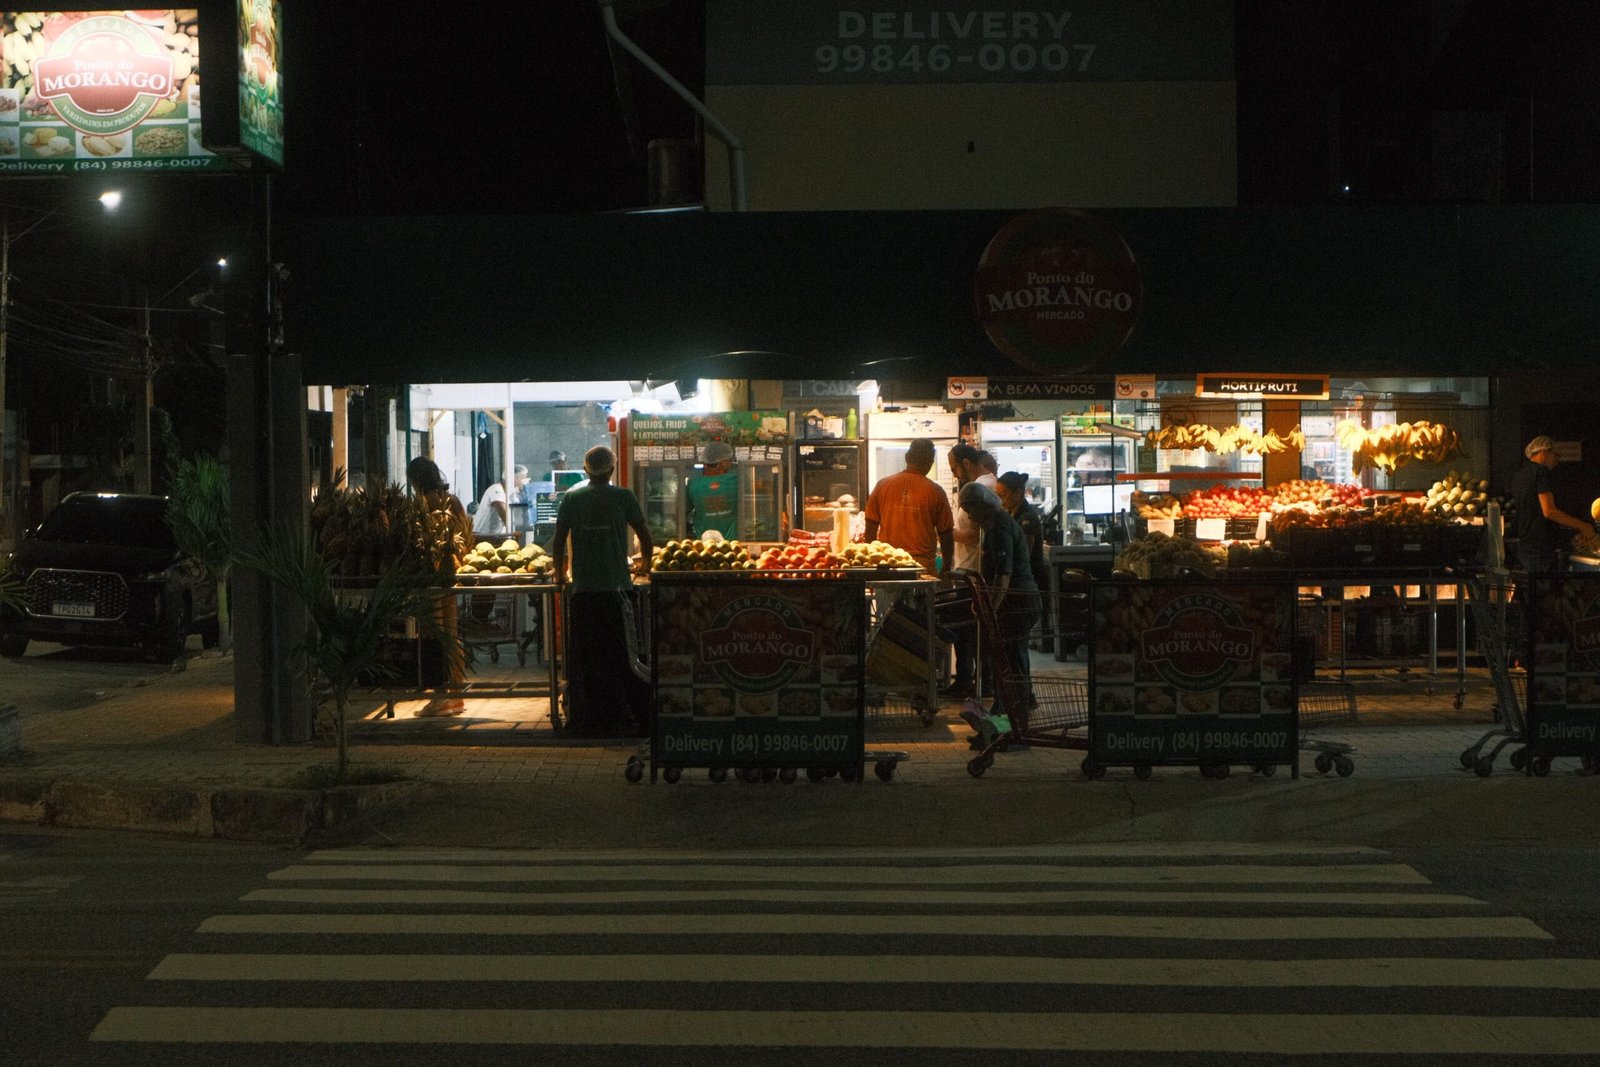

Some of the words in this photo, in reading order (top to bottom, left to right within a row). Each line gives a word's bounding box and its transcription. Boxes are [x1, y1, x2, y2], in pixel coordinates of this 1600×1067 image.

[838, 11, 1072, 39] DELIVERY
[75, 60, 113, 70] Ponto
[117, 60, 134, 70] do
[815, 43, 1096, 73] 99846-0007
[43, 71, 166, 92] MORANGO
[0, 162, 64, 172] Delivery
[74, 160, 106, 170] (84)
[1027, 272, 1071, 285] Ponto
[1075, 272, 1095, 284] do
[986, 286, 1132, 312] MORANGO
[1037, 311, 1085, 320] MERCADO
[812, 380, 858, 396] CAIX
[1006, 384, 1042, 396] BEM
[1044, 384, 1096, 395] VINDOS
[1220, 380, 1298, 392] HORTIFRUTI
[633, 420, 664, 430] QUEIJOS,
[666, 420, 688, 430] FRIOS
[724, 596, 792, 618] MERCADO
[1164, 597, 1232, 617] MERCADO
[732, 632, 765, 640] Ponto
[768, 632, 782, 640] do
[1174, 630, 1206, 640] Ponto
[1208, 630, 1222, 640] do
[708, 642, 808, 658] MORANGO
[1150, 640, 1248, 657] MORANGO
[1538, 721, 1596, 743] Delivery
[664, 734, 723, 754] Delivery
[731, 734, 758, 754] (84)
[764, 734, 848, 751] 99846-0007
[1107, 733, 1164, 752] Delivery
[1172, 732, 1200, 752] (84)
[1204, 732, 1287, 748] 99846-0007
